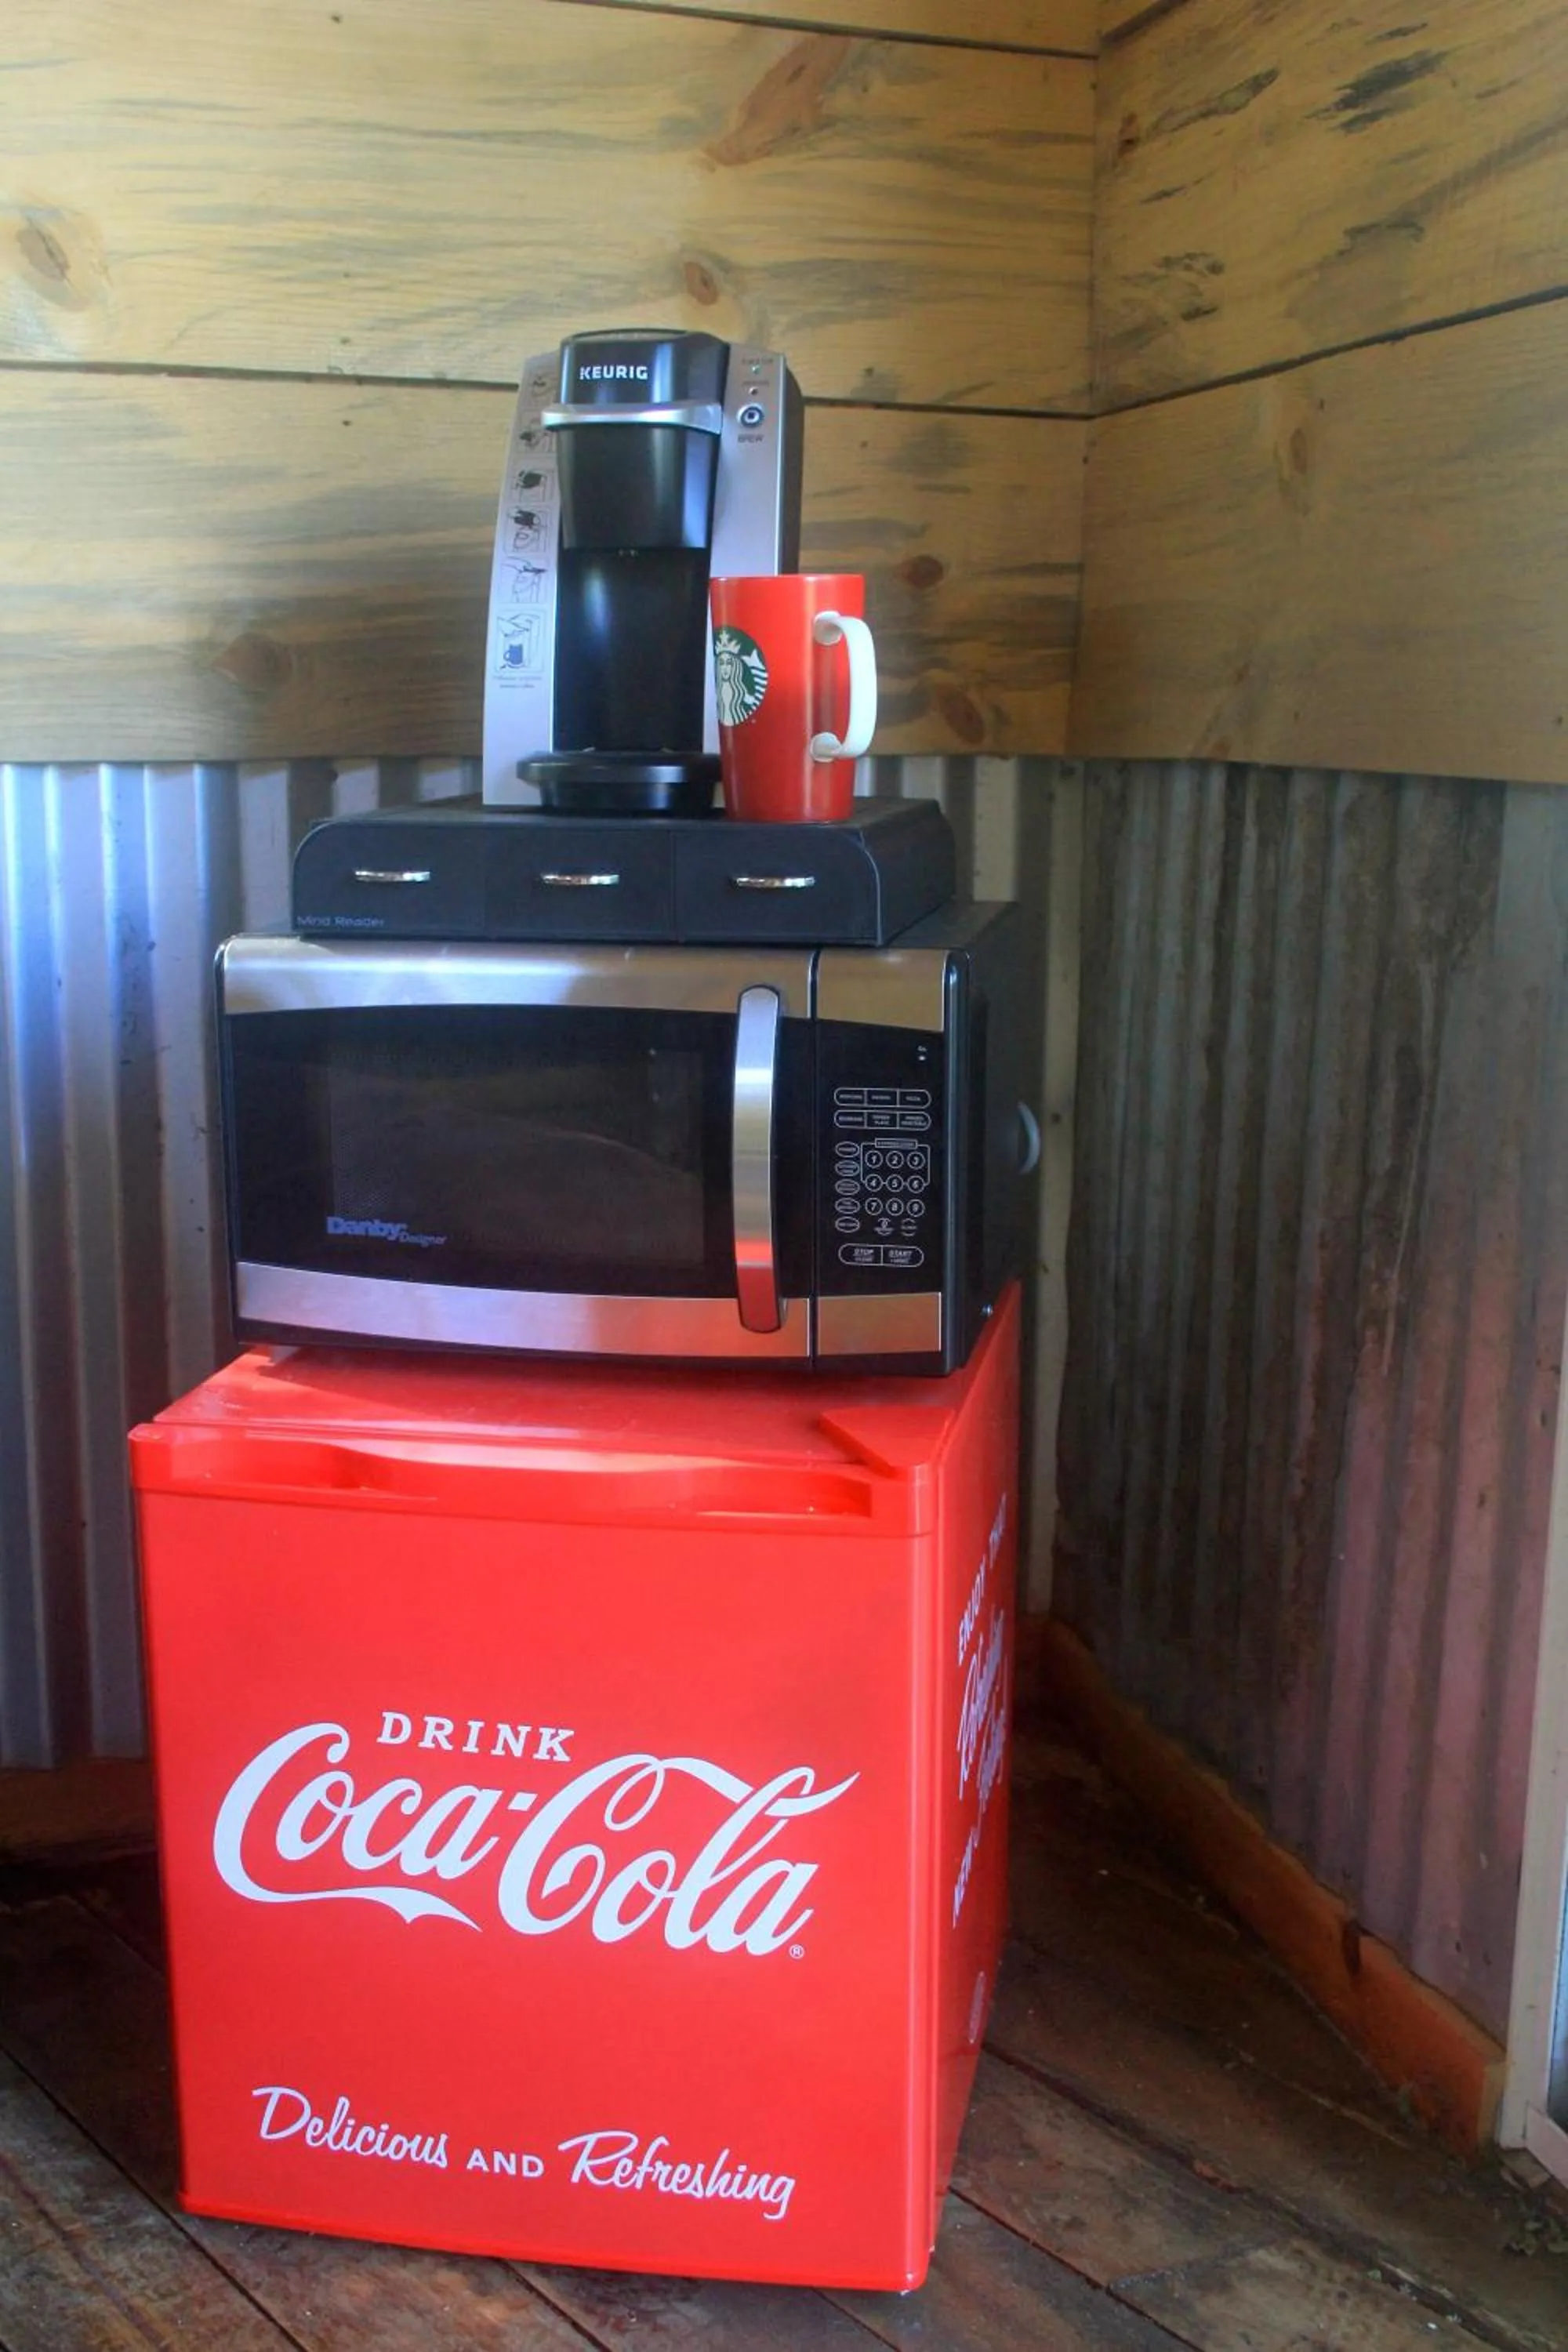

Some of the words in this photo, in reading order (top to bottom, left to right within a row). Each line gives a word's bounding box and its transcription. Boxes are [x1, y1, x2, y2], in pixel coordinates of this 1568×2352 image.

[579, 365, 648, 380] KEURIG
[892, 1156, 898, 1164] 2
[870, 1203, 877, 1211] 7
[326, 1216, 408, 1240] Danby
[958, 1555, 986, 1666] ENJOY
[377, 1711, 575, 1762] DRINK
[212, 1722, 860, 1956] Coca-Cola
[252, 2085, 448, 2169] Delicious
[466, 2148, 545, 2178] AND
[558, 2129, 796, 2220] Refreshing
